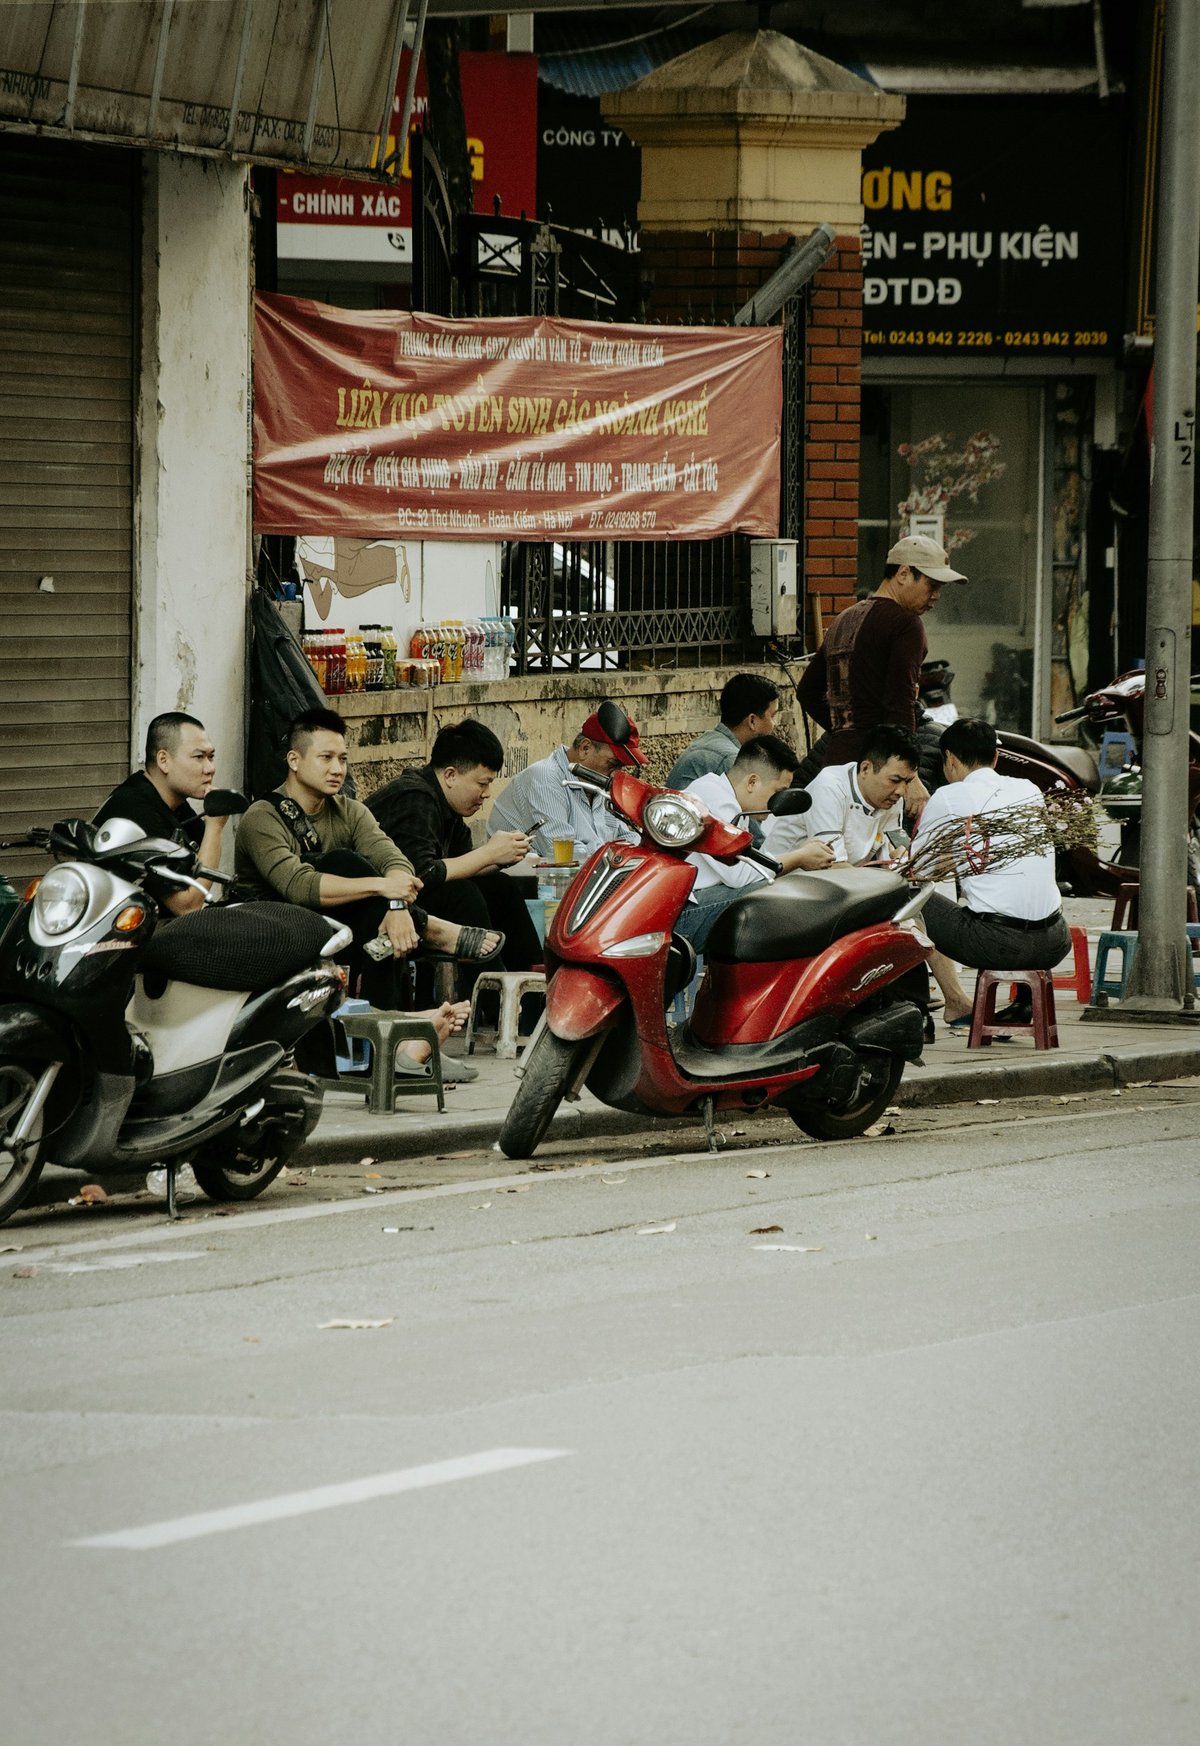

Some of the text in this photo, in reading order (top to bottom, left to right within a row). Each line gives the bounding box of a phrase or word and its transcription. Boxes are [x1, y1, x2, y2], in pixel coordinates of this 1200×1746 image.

[542, 125, 623, 147] CÔNG TY
[861, 165, 953, 212] ƠNG
[293, 189, 355, 216] CHÍNH
[361, 190, 401, 218] XÁC
[923, 231, 993, 268] PHỤ
[1000, 223, 1079, 268] KIỆN
[862, 277, 963, 306] ĐTDĐ
[400, 331, 431, 357] TRUNG
[433, 328, 454, 359] TÂM
[507, 328, 547, 361] NGUYỄN
[549, 334, 567, 363] VĂN
[590, 336, 615, 370] QUẬN
[616, 338, 641, 367] HOÀN
[642, 337, 665, 368] KIẾM
[863, 331, 886, 346] Tel:
[889, 331, 924, 346] 0243
[927, 331, 954, 346] 942
[1004, 331, 1039, 346] 0243
[1042, 331, 1069, 346] 942
[1073, 331, 1108, 346] 2039
[336, 378, 389, 429] LIÊN
[390, 392, 433, 440] TỤC
[432, 373, 504, 433] TUYỂN
[507, 396, 553, 435] SINH
[553, 387, 592, 436] CÁC
[595, 390, 662, 436] NGÀNH
[1181, 445, 1192, 465] 2
[323, 448, 354, 491] ĐIỆN
[373, 450, 399, 494] ĐIỆN
[401, 456, 421, 488] GIA
[420, 457, 451, 496] DỤNG
[547, 462, 567, 492] HOA
[575, 462, 591, 492] TIN
[592, 462, 613, 499] HỌC
[621, 462, 652, 492] TRANG
[702, 456, 719, 492] TÓC
[399, 507, 416, 527] ĐC:
[417, 508, 429, 528] 52
[431, 508, 448, 530] Thợ
[449, 509, 481, 532] Nhuộm
[488, 510, 512, 528] Hoàn
[513, 507, 537, 530] Kiếm
[543, 510, 557, 529] Hà
[557, 510, 573, 533] Nội
[588, 510, 604, 529] ĐT:
[641, 510, 657, 529] 570
